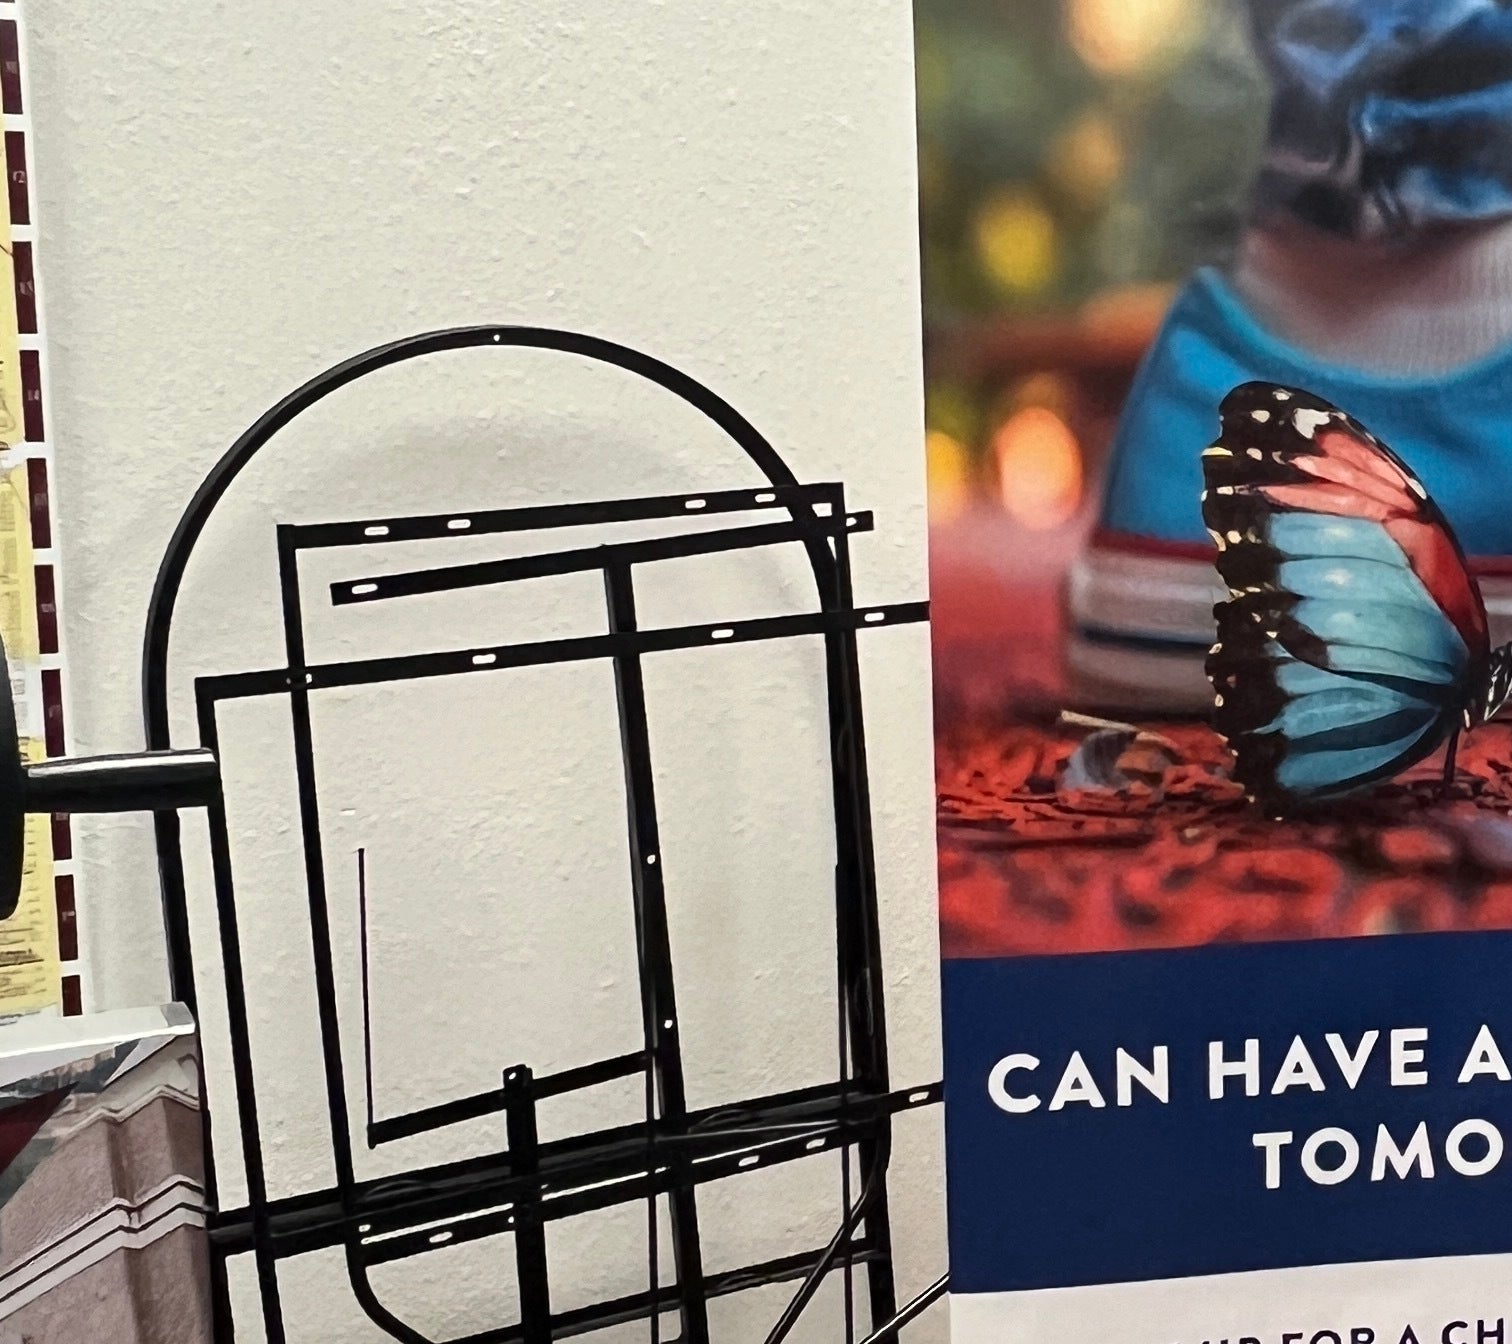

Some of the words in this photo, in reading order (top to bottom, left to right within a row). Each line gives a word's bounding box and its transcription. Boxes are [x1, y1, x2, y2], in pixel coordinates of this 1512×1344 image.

[988, 1046, 1168, 1112] CAN
[1209, 1028, 1427, 1099] HAVE
[1458, 1025, 1511, 1082] A
